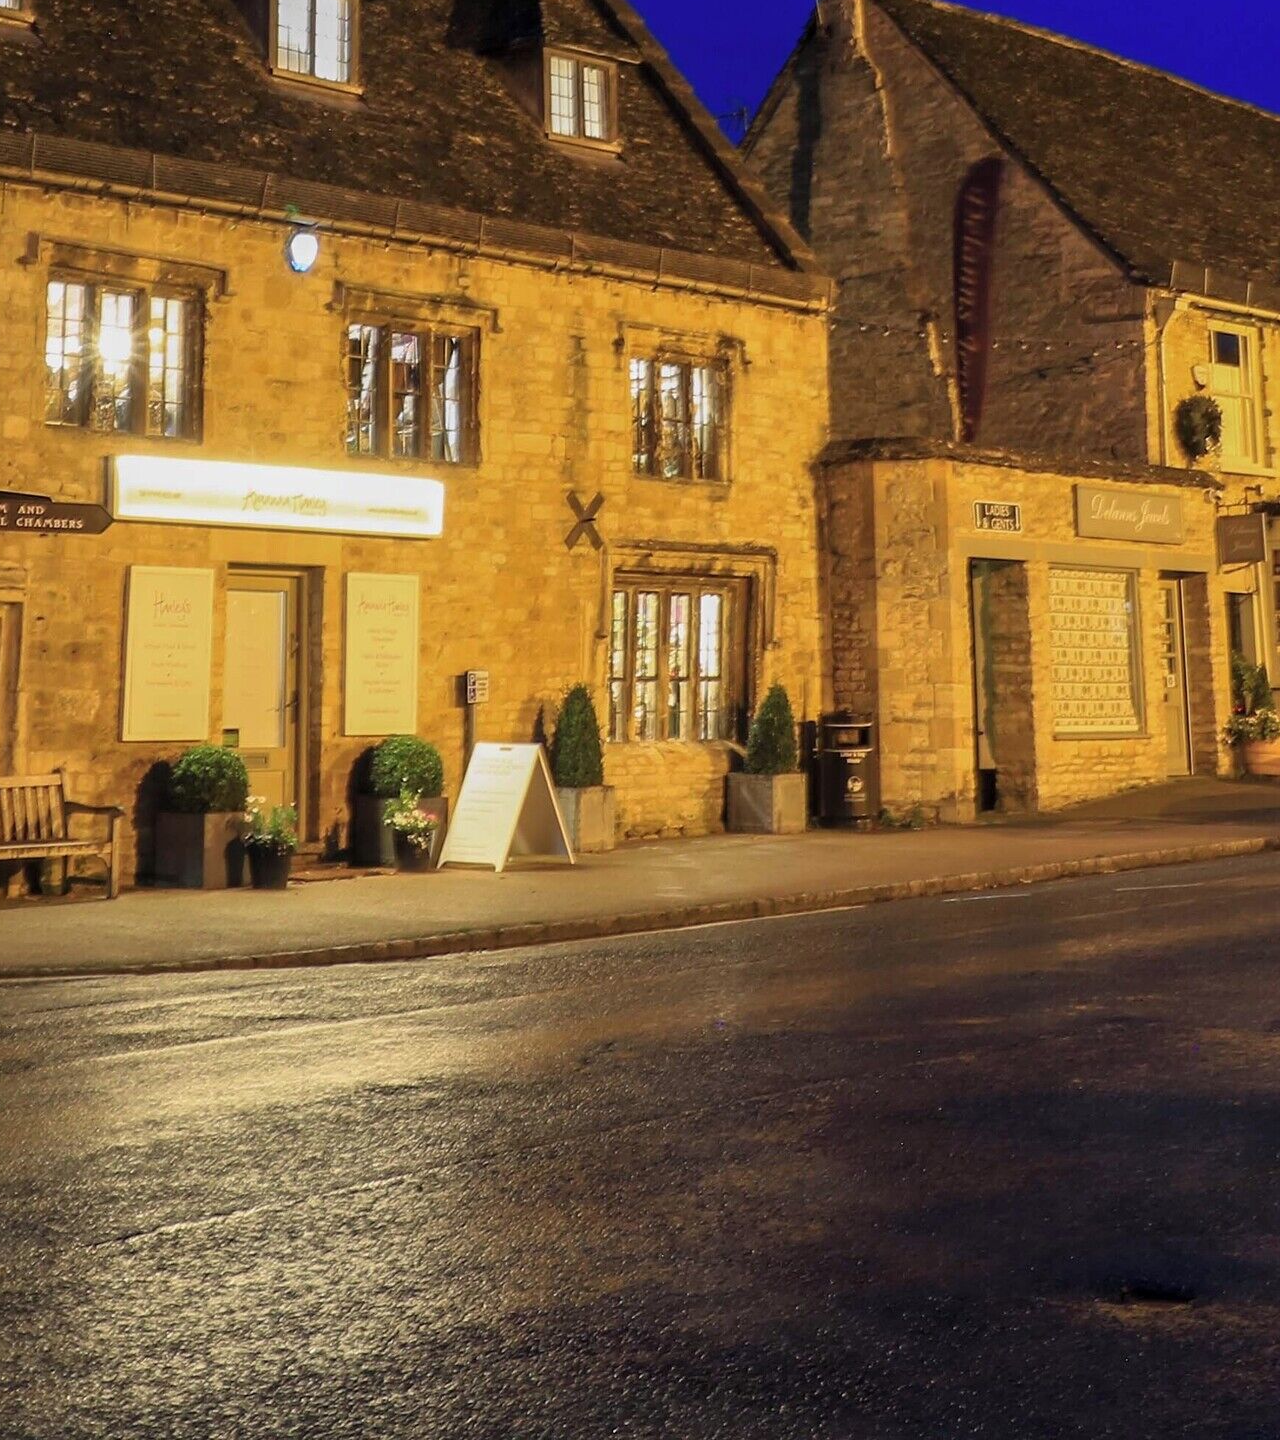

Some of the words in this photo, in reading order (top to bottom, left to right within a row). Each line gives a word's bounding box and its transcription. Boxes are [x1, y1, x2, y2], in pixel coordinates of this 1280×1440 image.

[18, 505, 45, 515] AND
[984, 504, 1010, 517] LADIES
[16, 517, 84, 529] CHAMBERS
[991, 517, 1015, 531] GENTS
